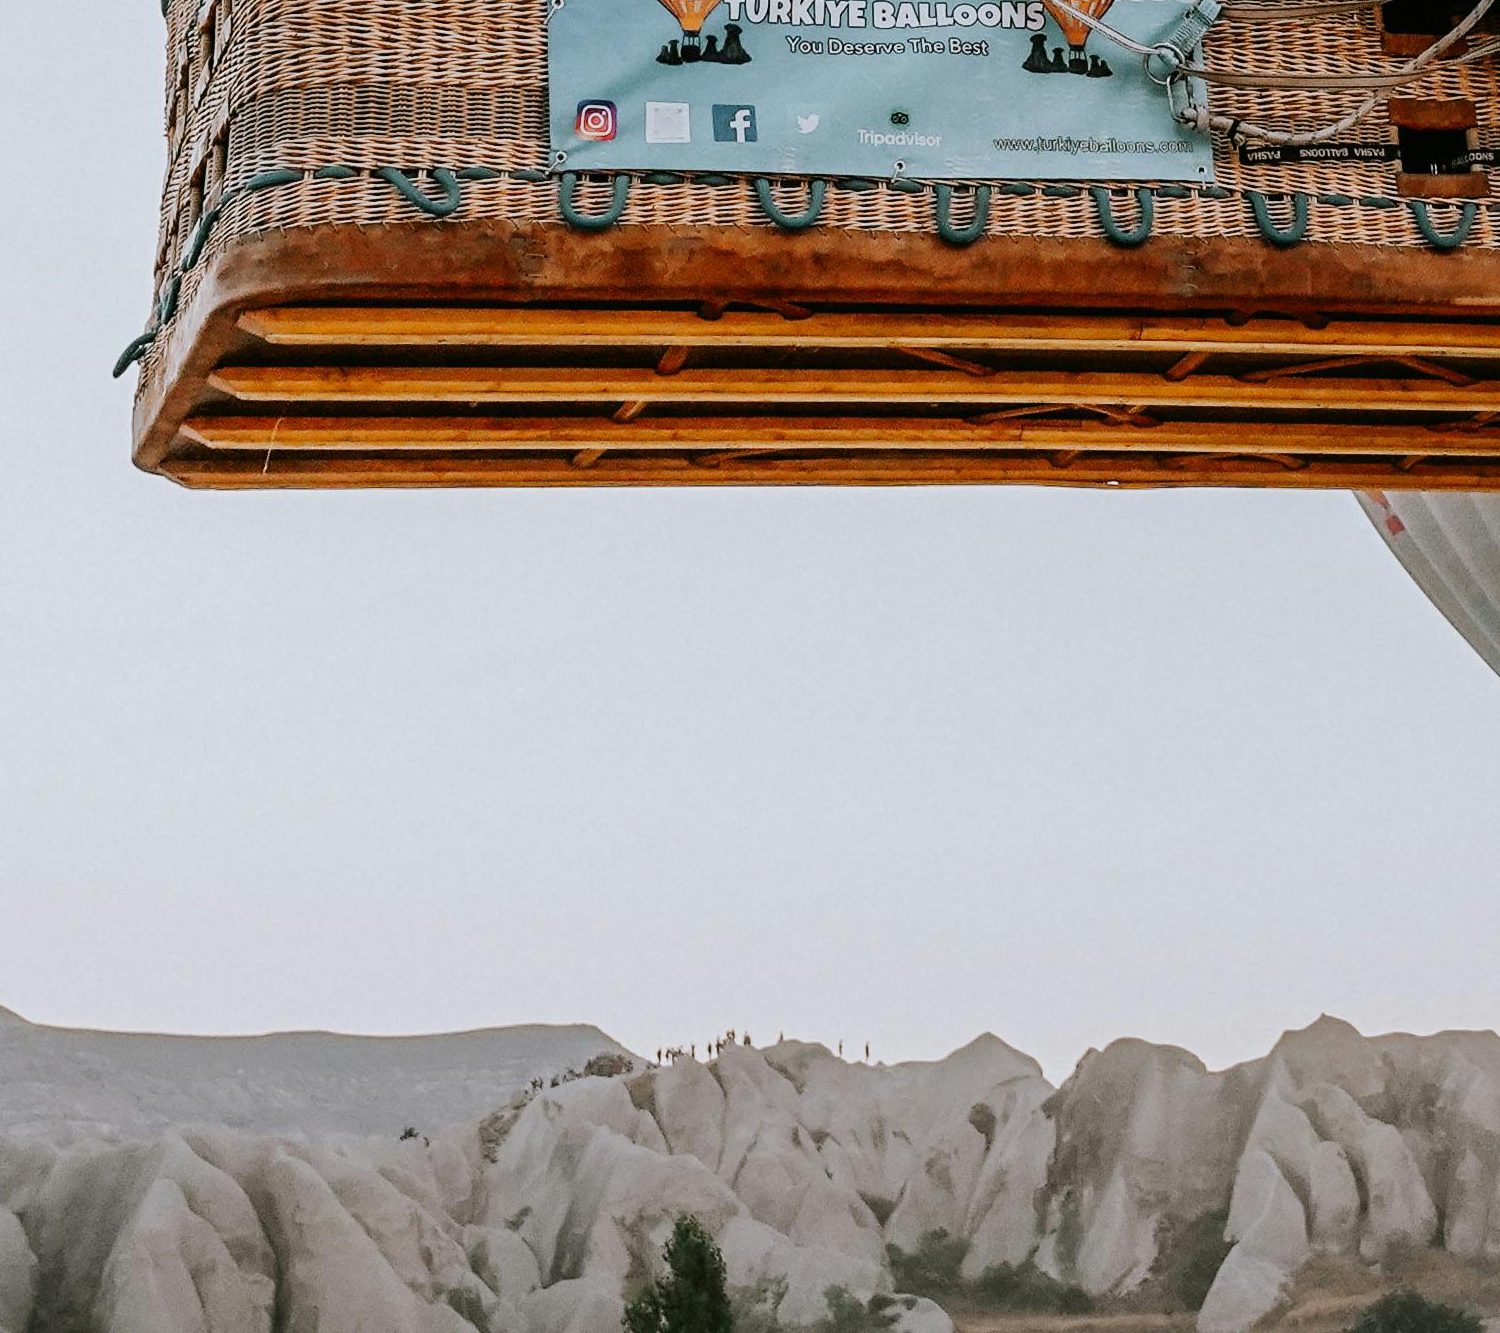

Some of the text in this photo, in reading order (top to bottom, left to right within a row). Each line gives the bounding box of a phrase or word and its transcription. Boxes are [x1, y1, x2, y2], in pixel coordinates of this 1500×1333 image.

[872, 0, 1046, 31] BALLOONS
[785, 35, 989, 56] You Deserve The Best
[857, 129, 942, 148] Tripadvisor
[992, 135, 1195, 156] www.turkiyeballoons.com
[1247, 147, 1386, 161] PASHA BALLOONS PASHA
